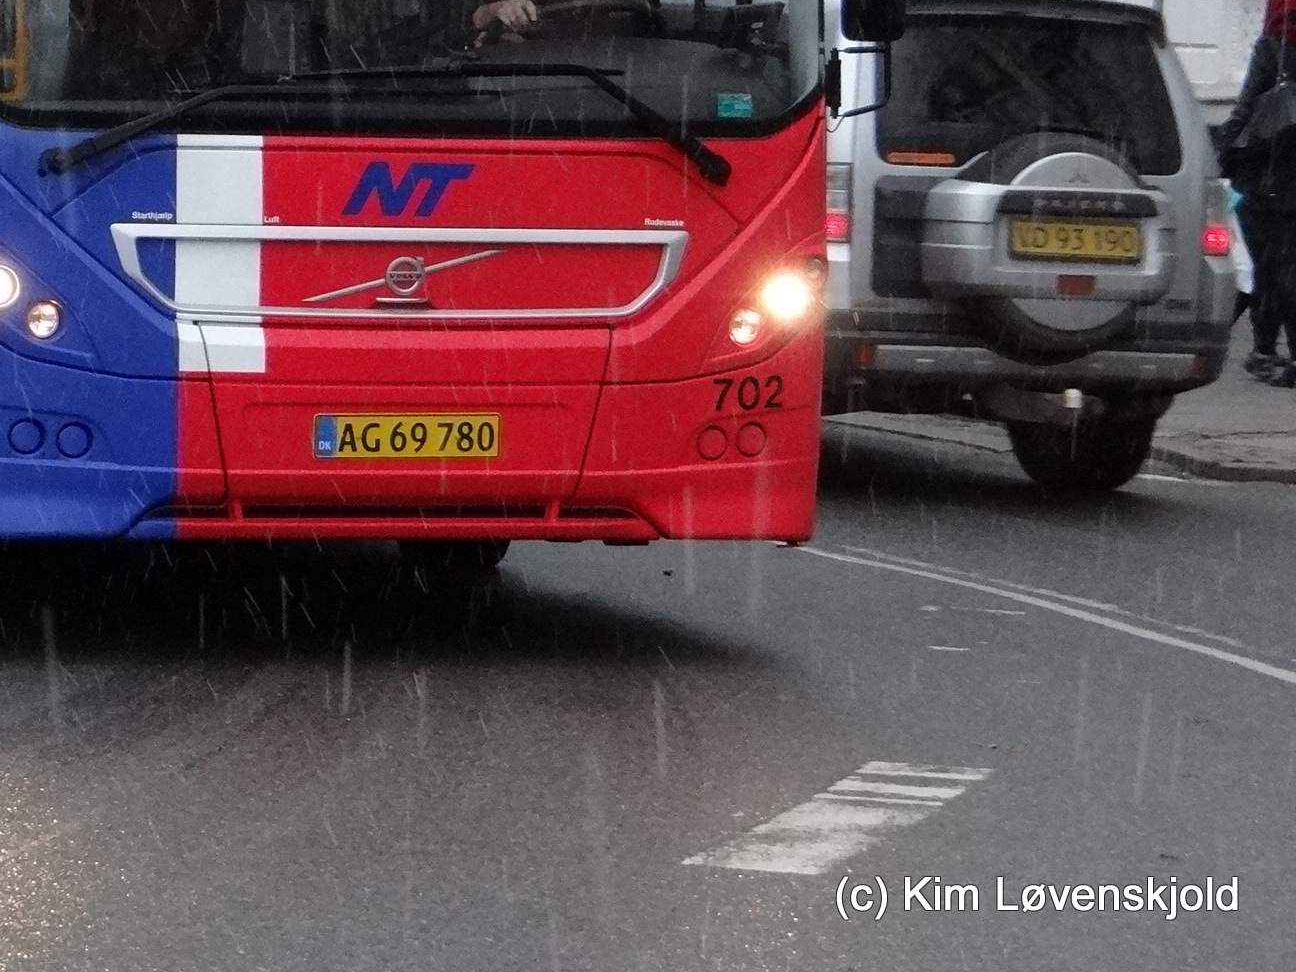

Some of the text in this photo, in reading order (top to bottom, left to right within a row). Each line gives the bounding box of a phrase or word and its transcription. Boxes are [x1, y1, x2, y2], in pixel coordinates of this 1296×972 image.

[341, 161, 476, 217] NT
[264, 215, 280, 223] Luft
[1055, 227, 1085, 251] 93
[388, 272, 423, 280] VOLVO
[713, 375, 784, 412] 702
[318, 440, 332, 451] DK
[338, 421, 495, 453] AG 69 780
